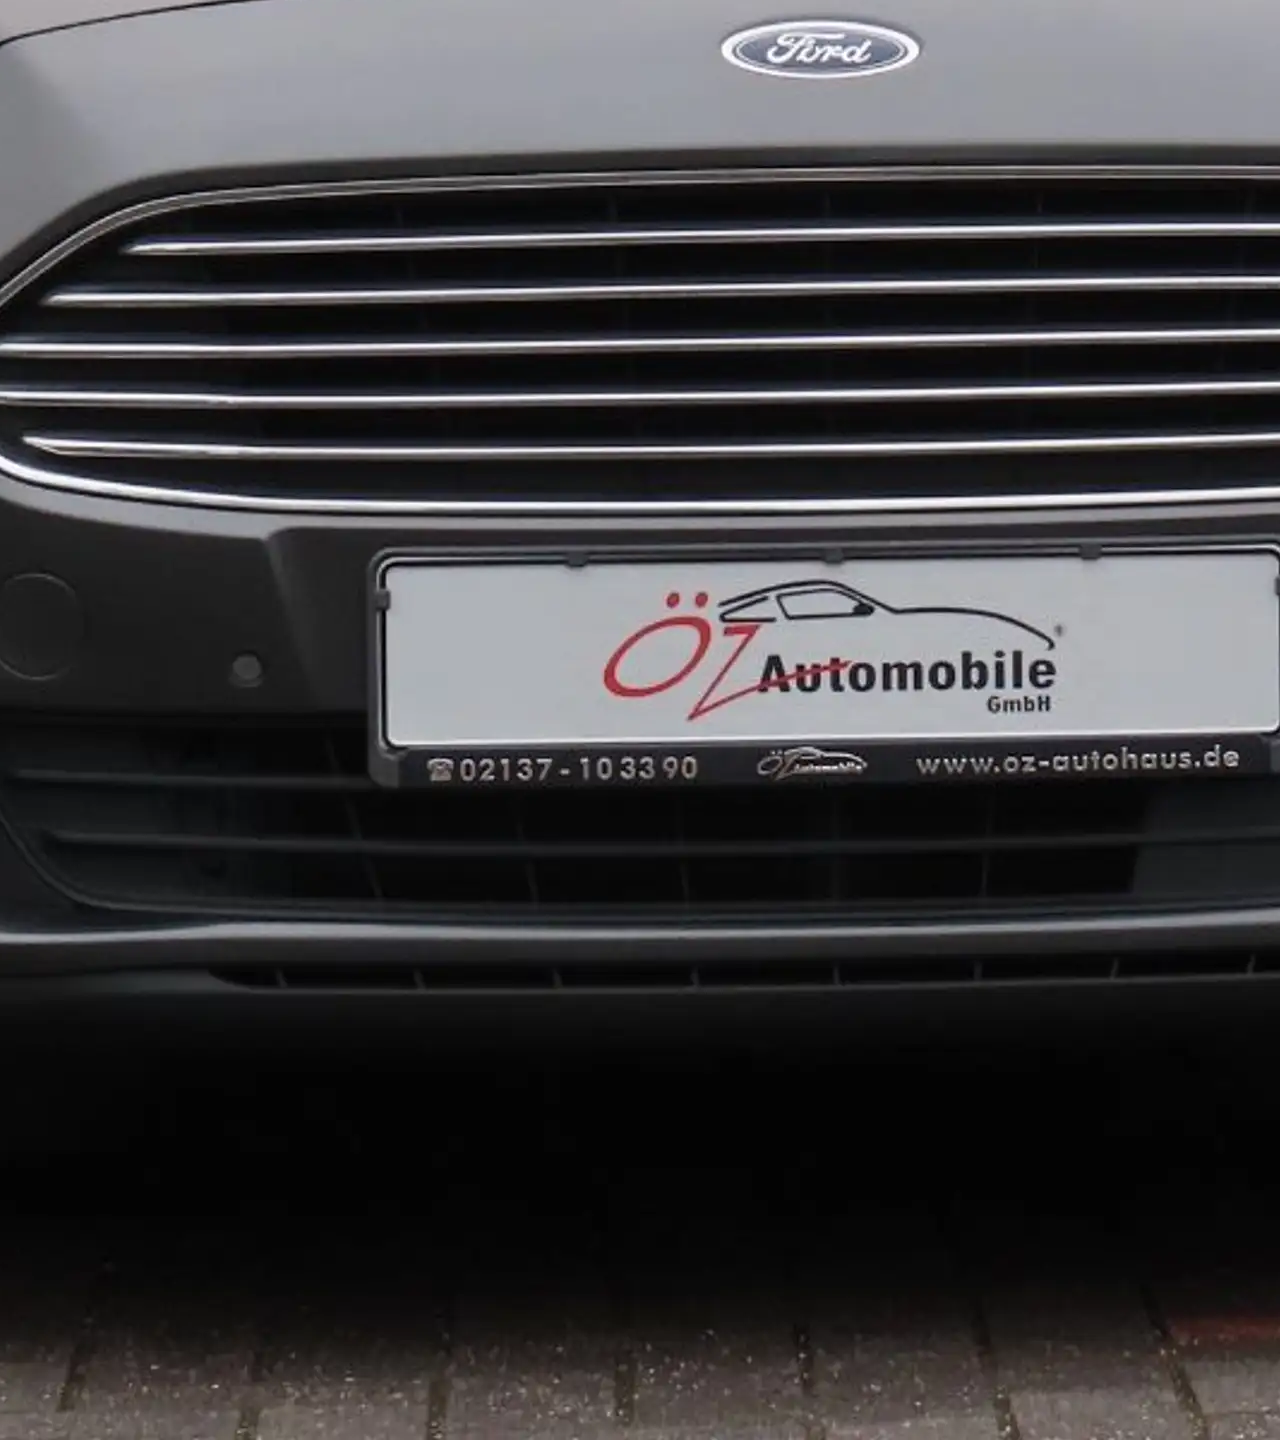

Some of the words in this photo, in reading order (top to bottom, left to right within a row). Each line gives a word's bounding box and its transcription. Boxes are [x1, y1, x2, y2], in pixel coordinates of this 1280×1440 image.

[766, 32, 872, 63] Ford
[602, 591, 851, 721] ÖZ
[757, 649, 1057, 693] Automobile
[986, 694, 1051, 714] GmbH
[460, 758, 553, 781] 02137
[916, 744, 1240, 774] www.oz-autohaus.de
